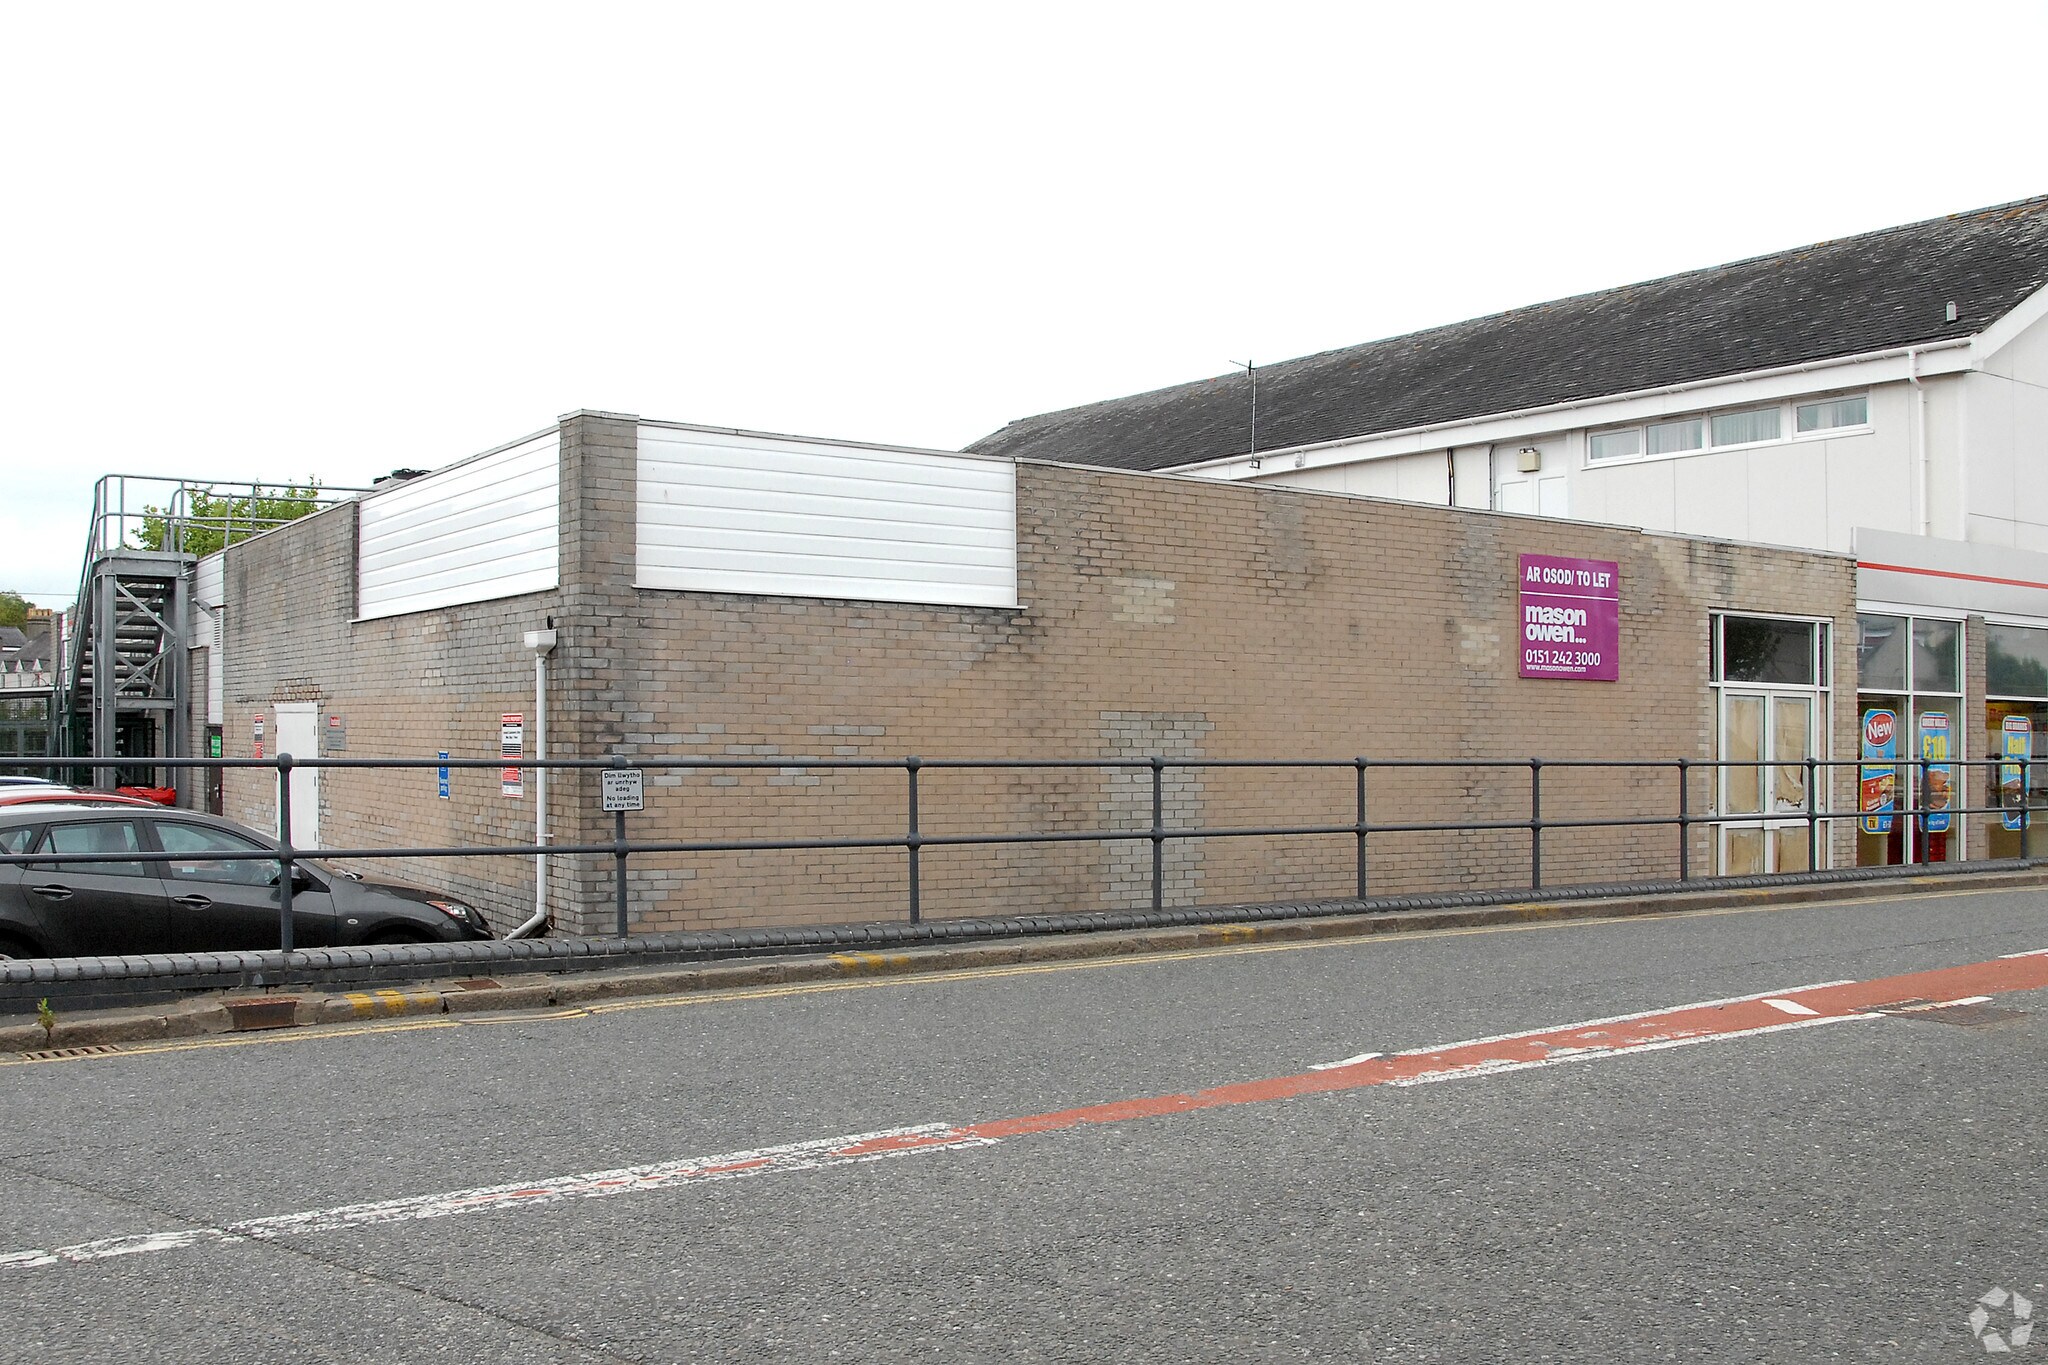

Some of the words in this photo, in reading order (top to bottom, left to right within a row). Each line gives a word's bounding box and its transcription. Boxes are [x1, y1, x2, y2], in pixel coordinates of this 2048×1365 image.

[1526, 566, 1541, 582] AR
[1543, 567, 1574, 585] OSOD/
[1577, 570, 1590, 587] TO
[1593, 571, 1611, 588] LET
[1525, 605, 1587, 626] mason
[1525, 649, 1549, 664] 0151
[1552, 650, 1573, 665] 242
[1575, 651, 1601, 667] 3000
[1868, 721, 1893, 740] New
[1923, 735, 1947, 761] £10
